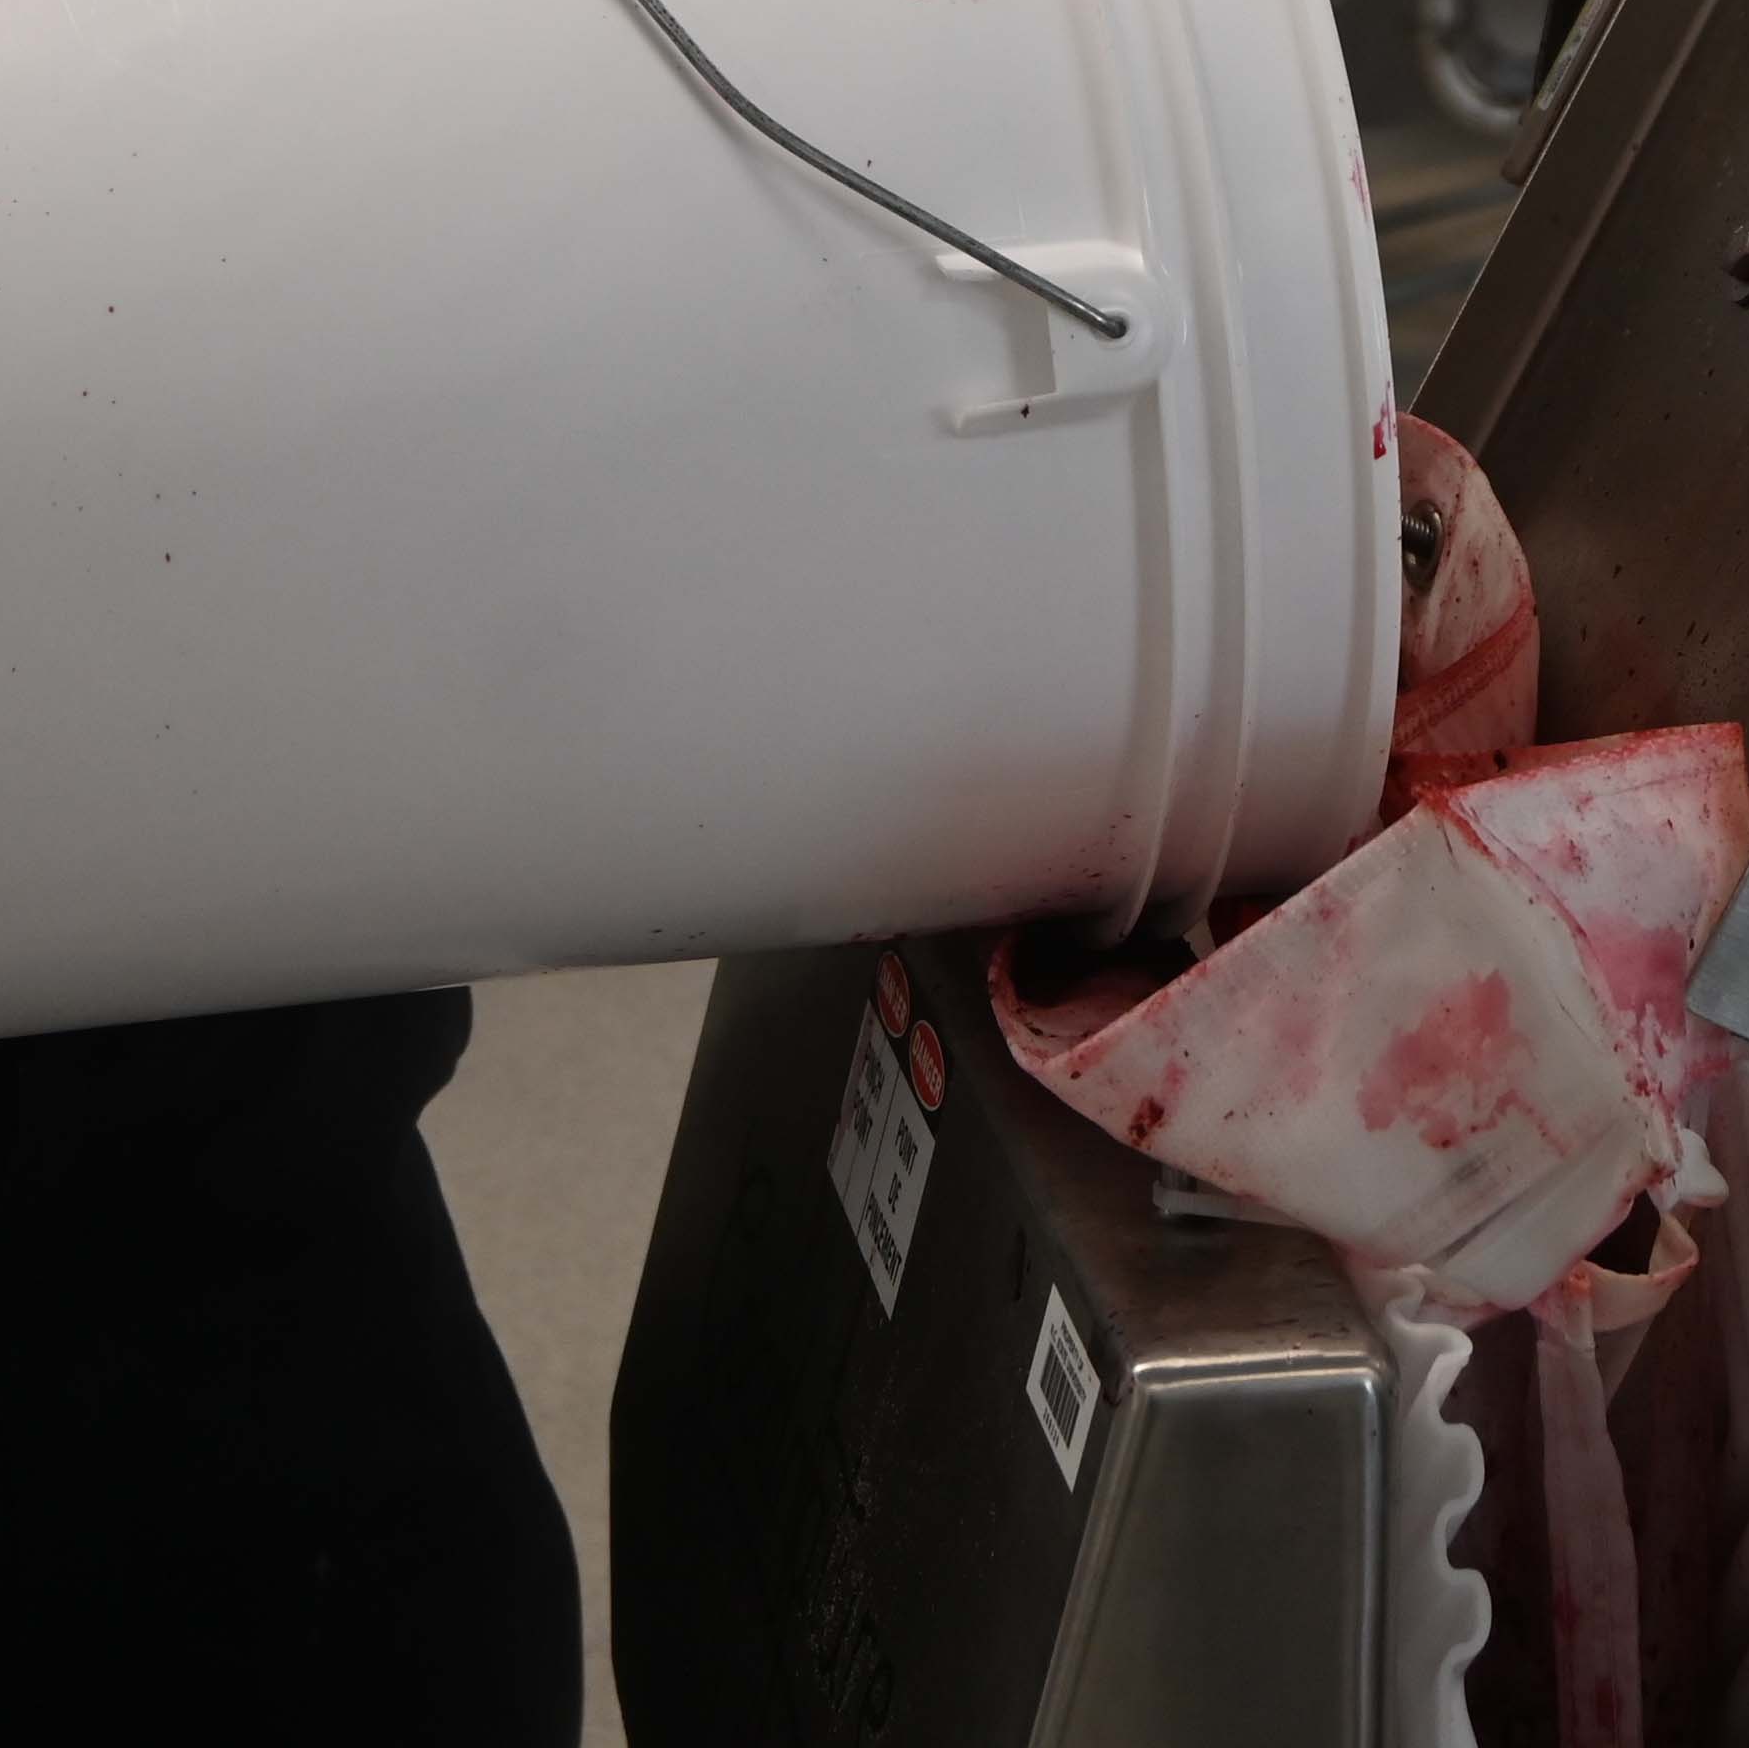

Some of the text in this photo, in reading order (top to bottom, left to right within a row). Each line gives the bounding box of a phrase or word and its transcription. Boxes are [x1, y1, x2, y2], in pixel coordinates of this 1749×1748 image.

[910, 1027, 943, 1103] DANGER
[894, 1114, 918, 1180] POINT
[887, 1170, 901, 1215] DE
[864, 1189, 901, 1289] PINCEMENT
